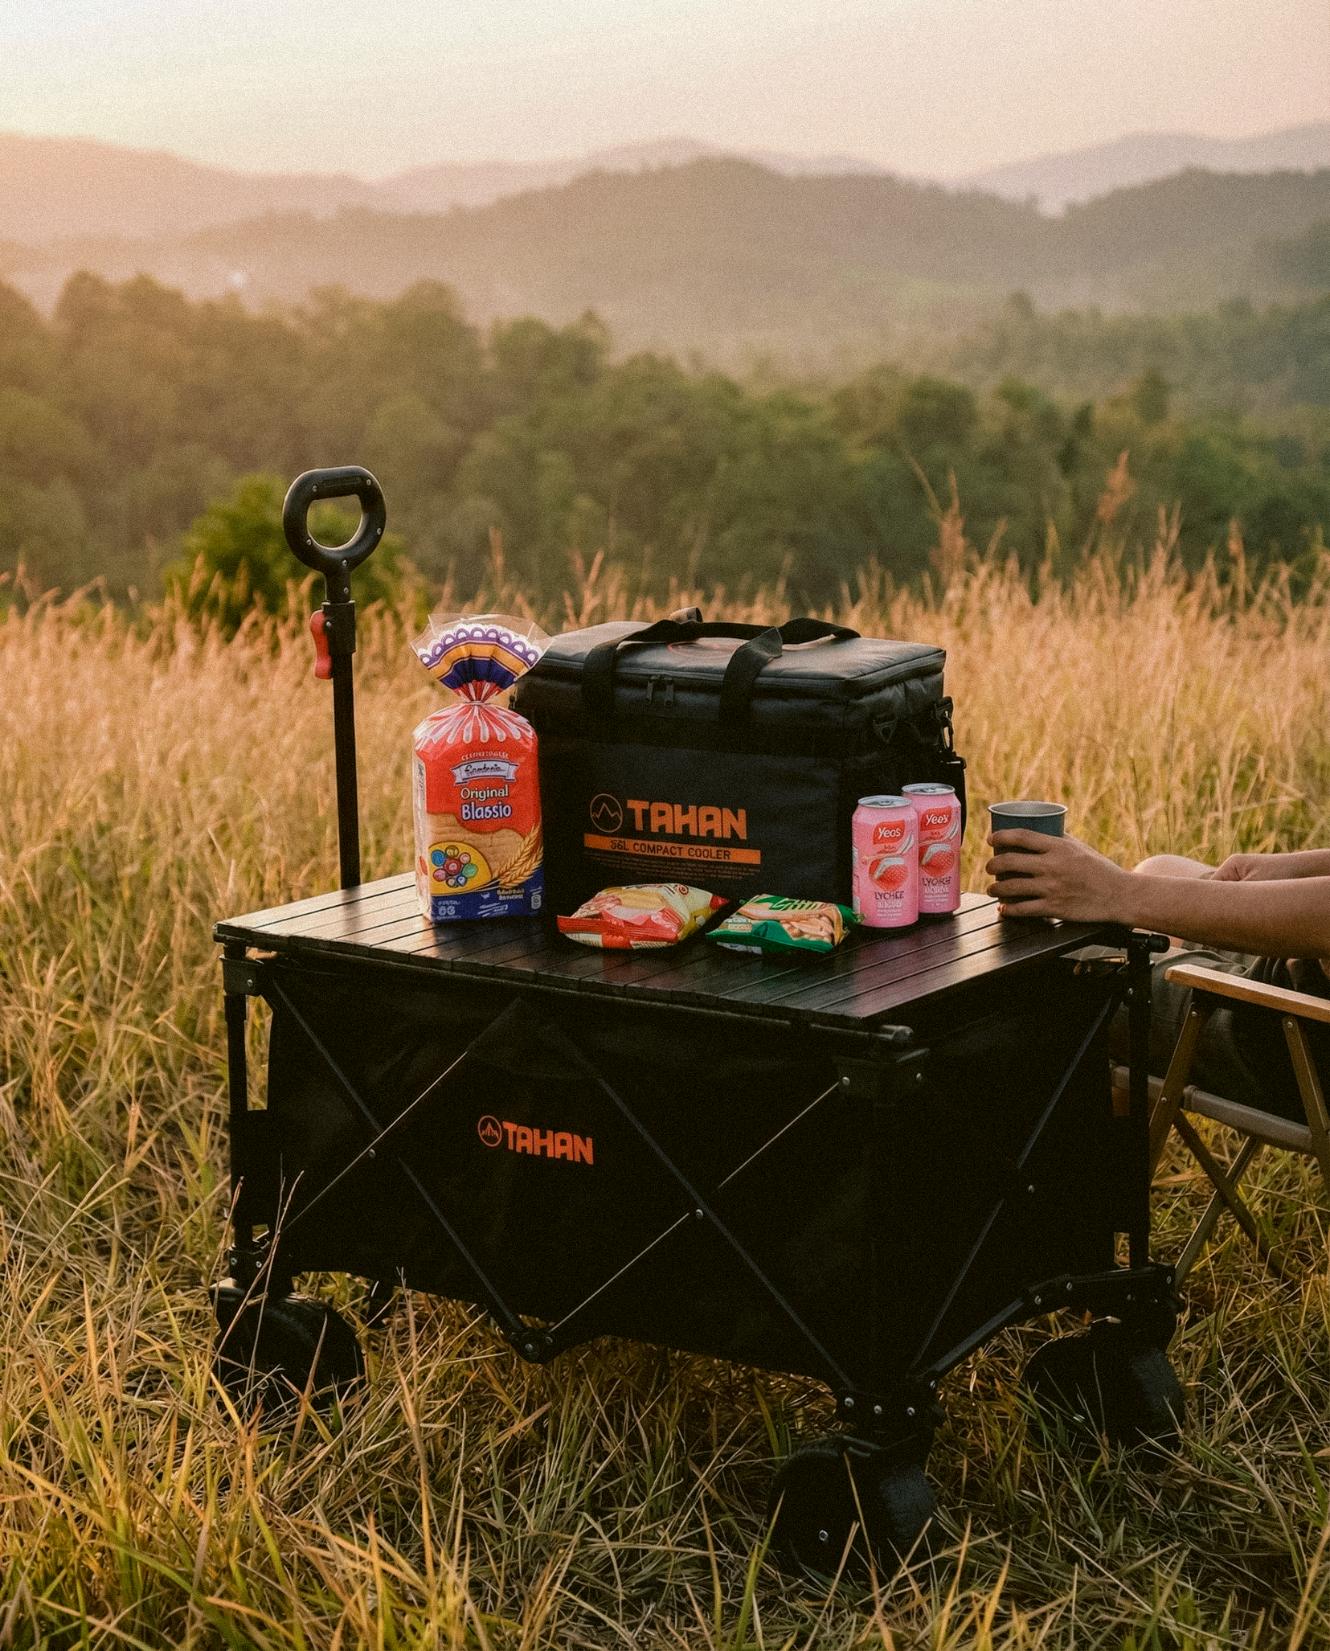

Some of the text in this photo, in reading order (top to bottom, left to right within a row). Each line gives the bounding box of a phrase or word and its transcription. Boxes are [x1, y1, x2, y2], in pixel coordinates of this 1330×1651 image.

[460, 784, 509, 802] Original
[626, 799, 748, 840] TAHAN
[633, 842, 683, 856] COMPACT
[687, 847, 731, 860] COOLER
[502, 1120, 594, 1166] TAHAN
